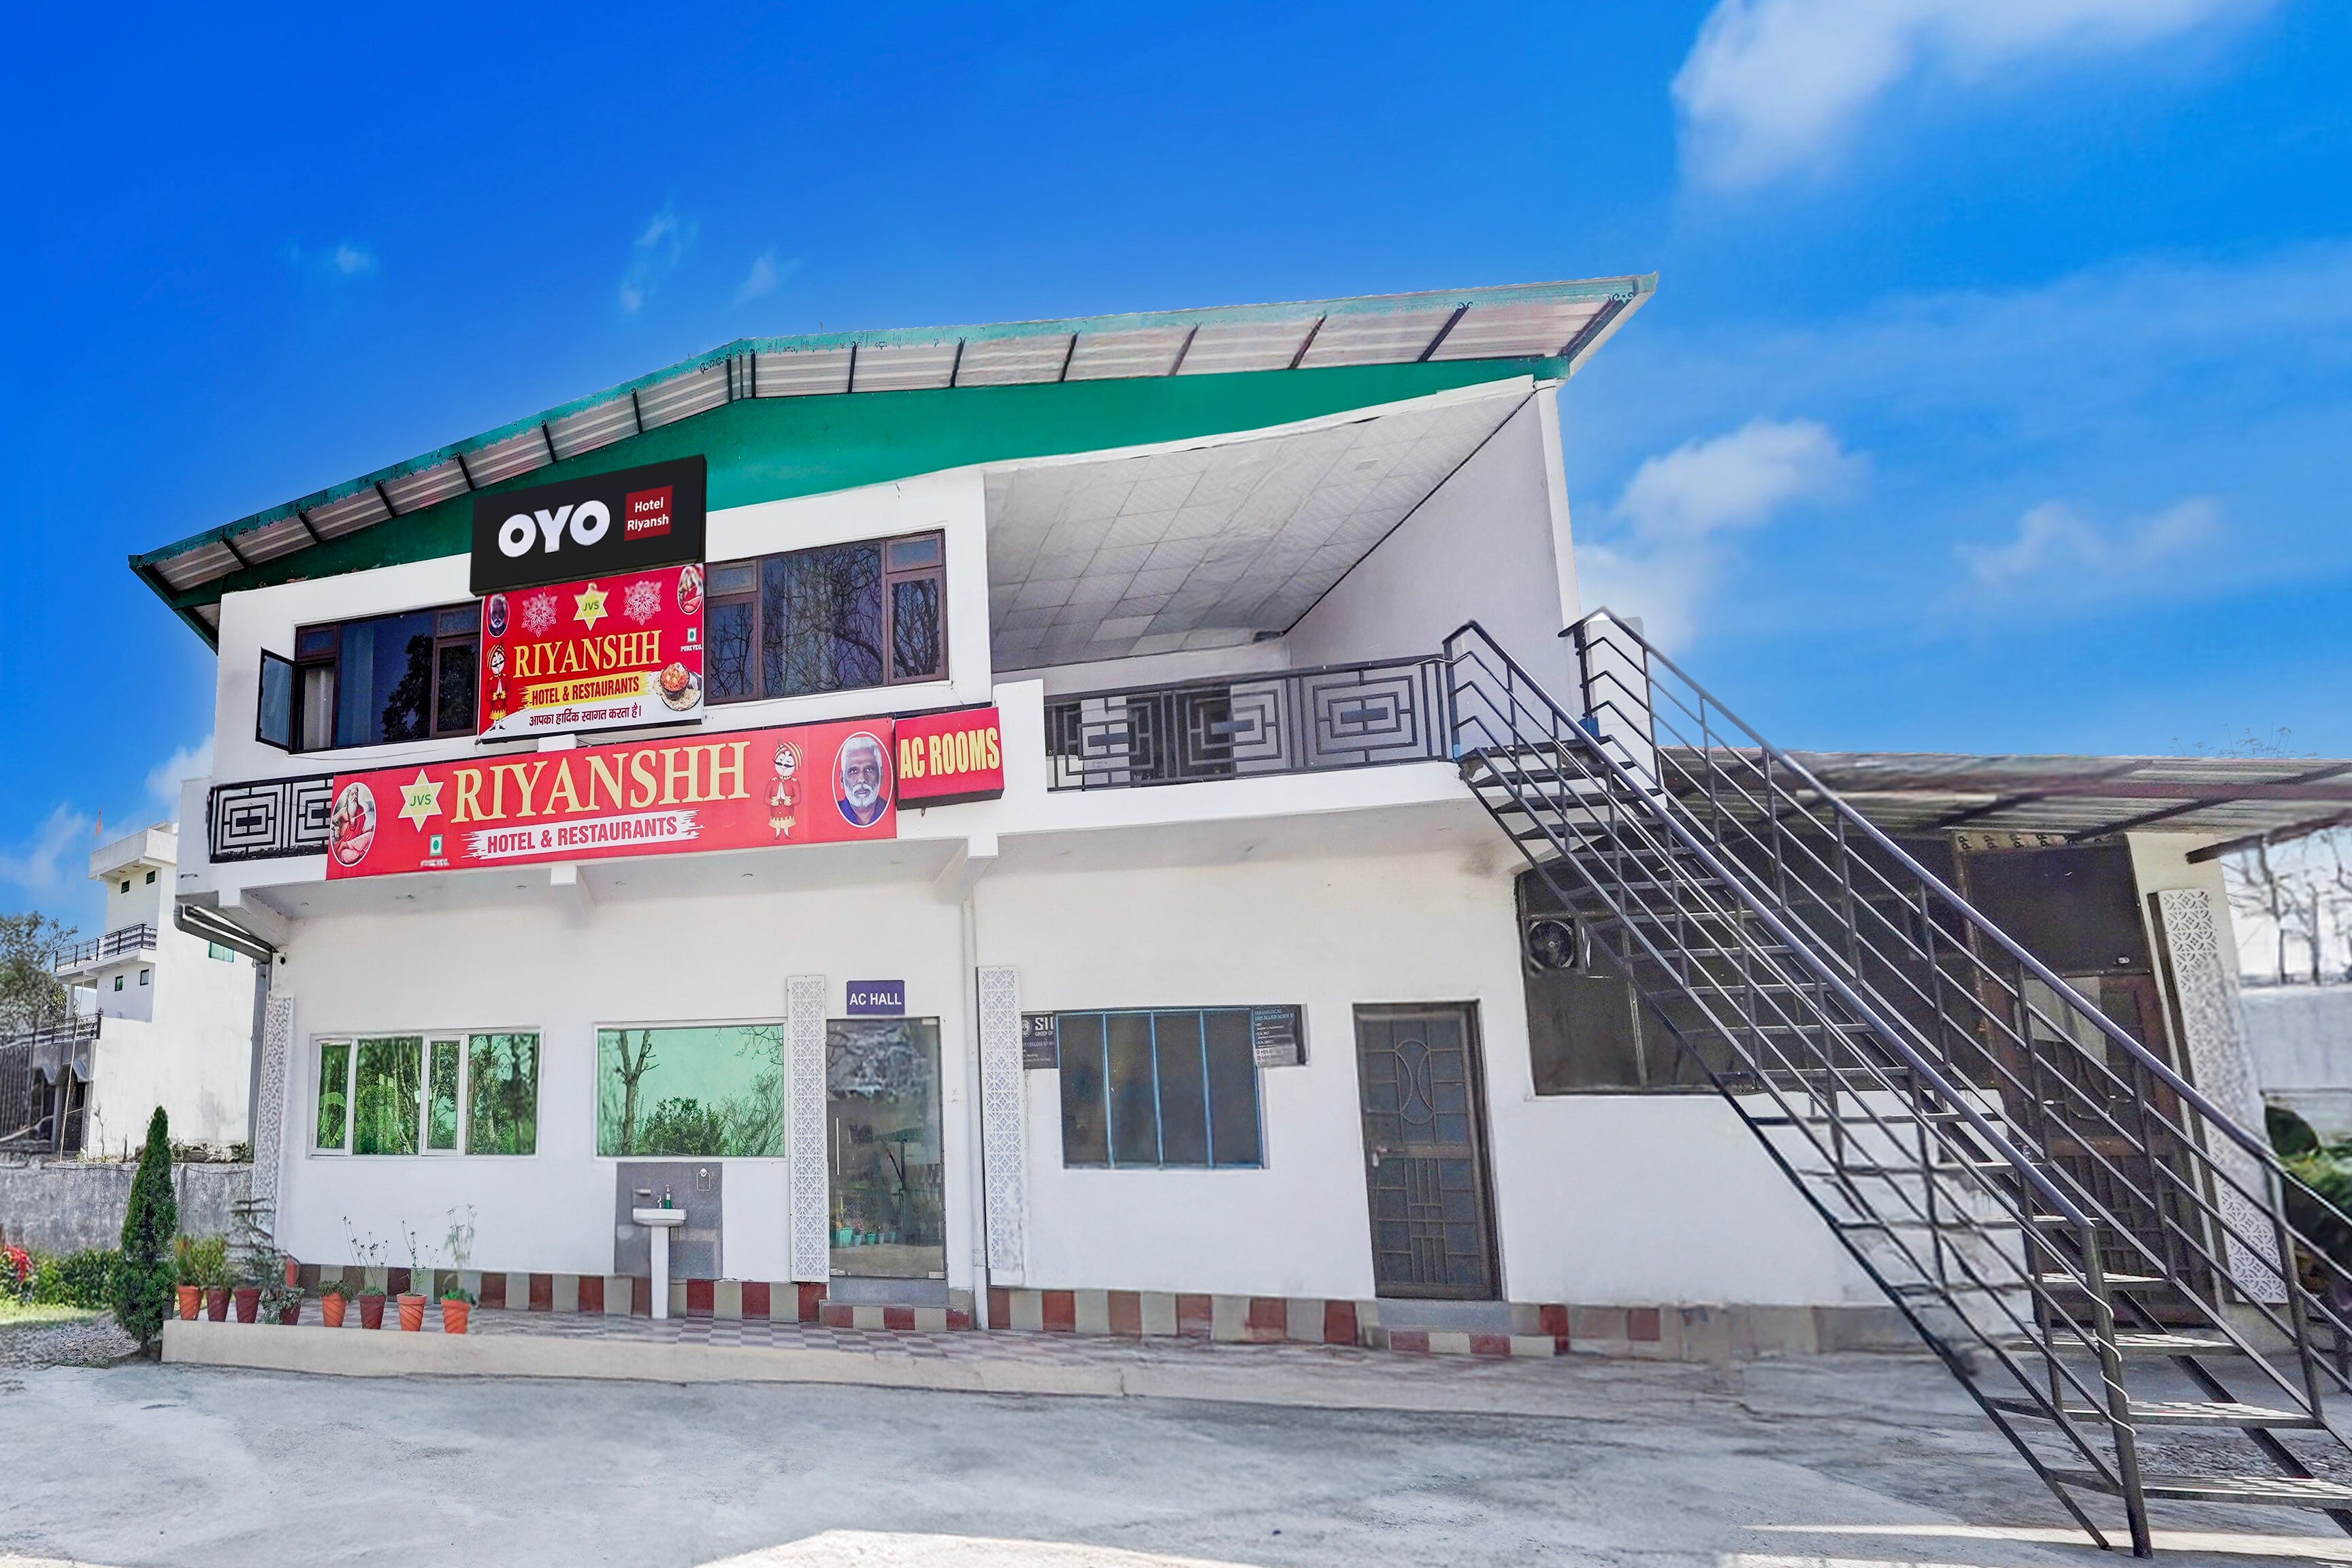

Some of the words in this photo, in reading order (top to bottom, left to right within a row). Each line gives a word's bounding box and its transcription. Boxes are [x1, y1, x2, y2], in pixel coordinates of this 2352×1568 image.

[634, 497, 664, 512] Hotel
[498, 500, 610, 557] OYO
[583, 600, 600, 612] JVS
[513, 630, 662, 679] RIYANSHH
[532, 687, 560, 706] HOTEL
[562, 687, 570, 701] &
[572, 676, 640, 700] RESTAURANTS
[529, 714, 554, 727] आपका
[555, 708, 580, 725] हार्दिक
[581, 709, 607, 722] स्वागत
[608, 706, 630, 719] करता
[900, 735, 925, 779] AC
[930, 727, 1000, 776] ROOMS
[450, 740, 751, 823] RIYANSHH
[410, 794, 432, 806] JVS
[487, 831, 536, 853] HOTEL
[540, 828, 553, 848] &
[558, 816, 677, 846] RESTAURANTS
[849, 993, 866, 1005] AC
[870, 993, 902, 1005] HALL
